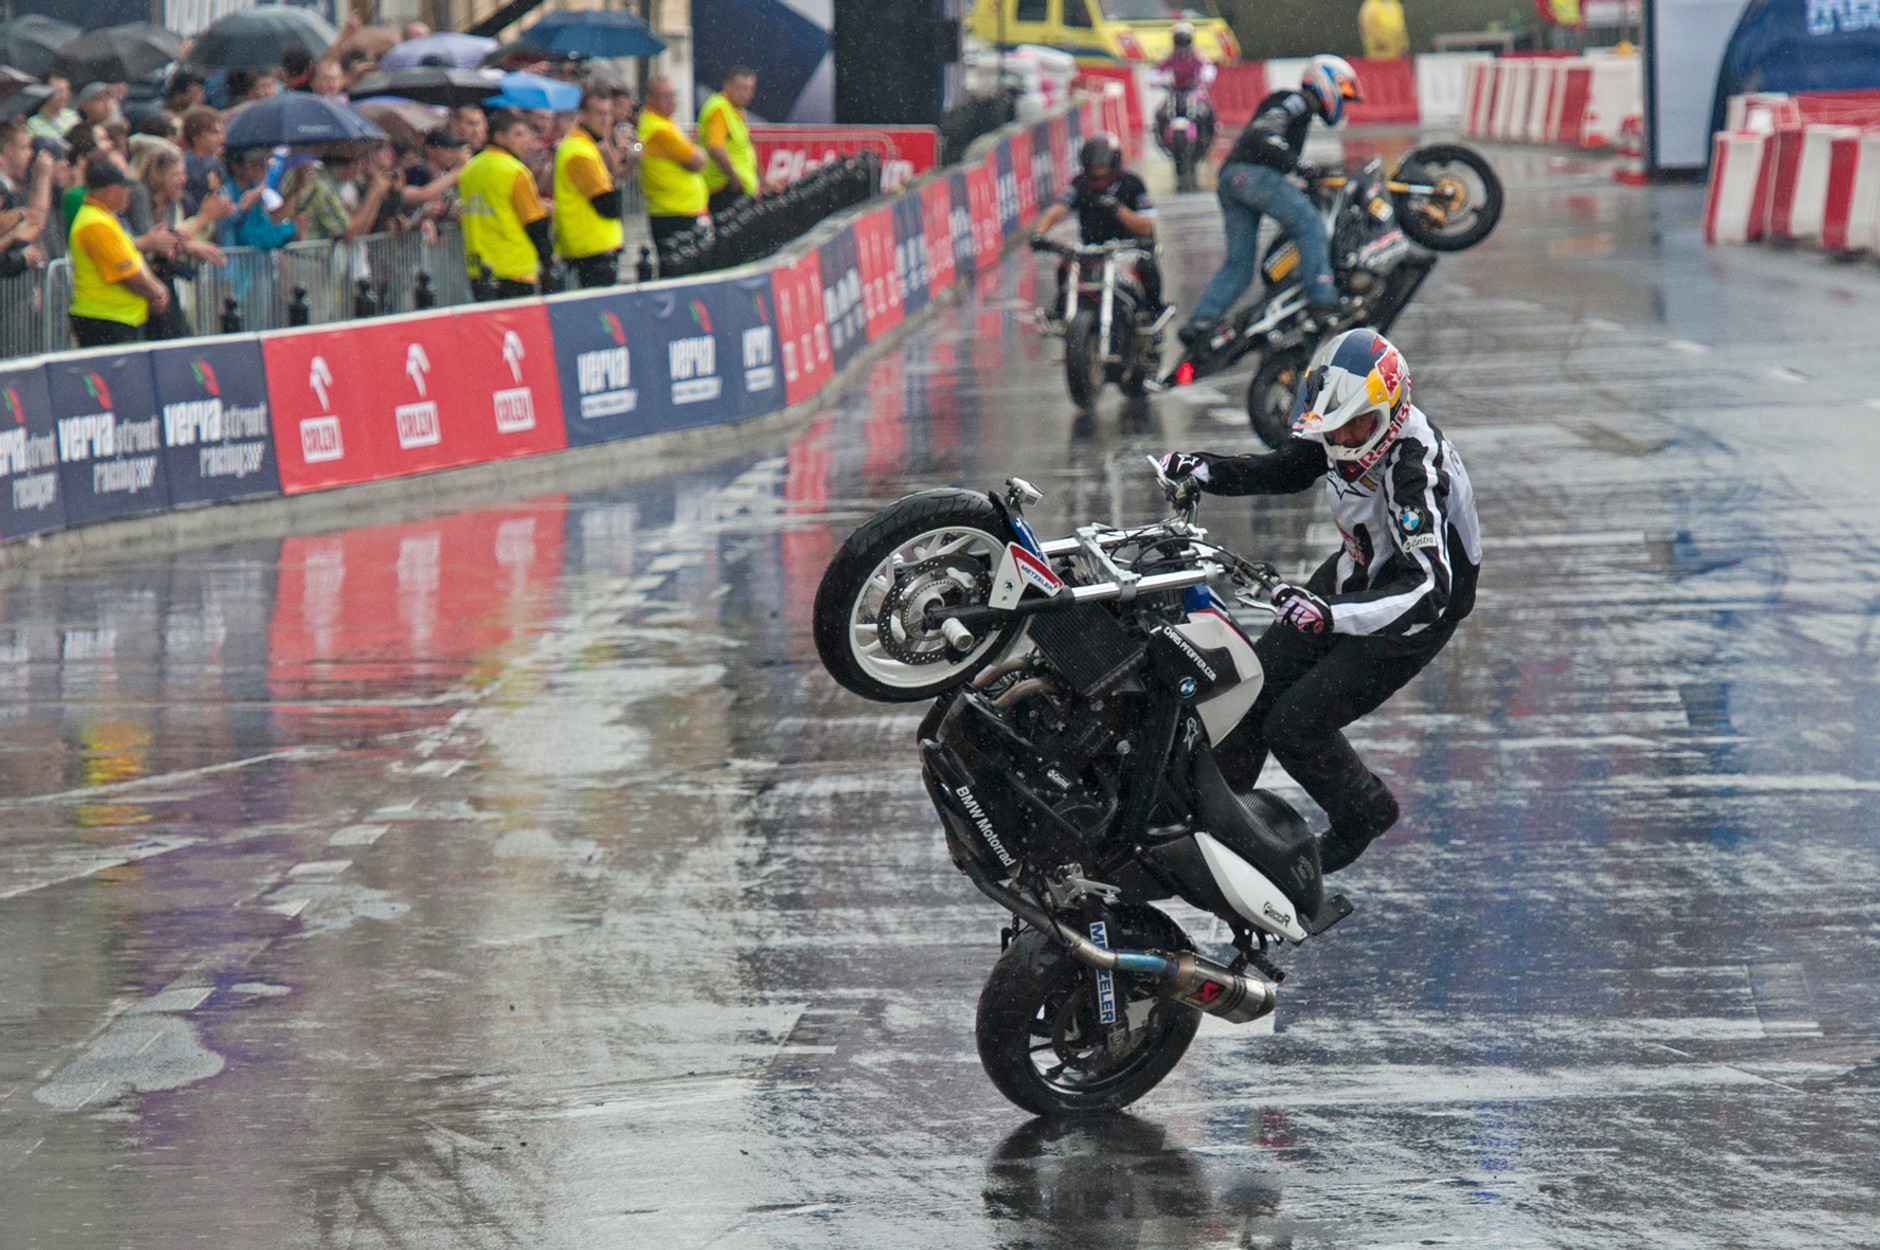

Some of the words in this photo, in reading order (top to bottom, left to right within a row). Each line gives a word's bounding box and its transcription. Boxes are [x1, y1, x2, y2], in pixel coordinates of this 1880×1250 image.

[577, 346, 630, 394] verva
[669, 335, 716, 380] verva
[58, 411, 114, 463] verva
[114, 415, 160, 453] street
[163, 398, 222, 447] verva
[222, 403, 267, 440] street
[303, 425, 337, 454] ORLEN
[402, 412, 433, 440] ORLEN
[1357, 422, 1400, 468] Red
[94, 456, 138, 494] racing
[200, 441, 245, 478] racing
[1021, 564, 1054, 592] METZELER
[1163, 626, 1183, 645] CHRIS
[956, 785, 985, 819] BMW
[976, 817, 1017, 867] Motorrad
[1090, 922, 1115, 1023] MZELER
